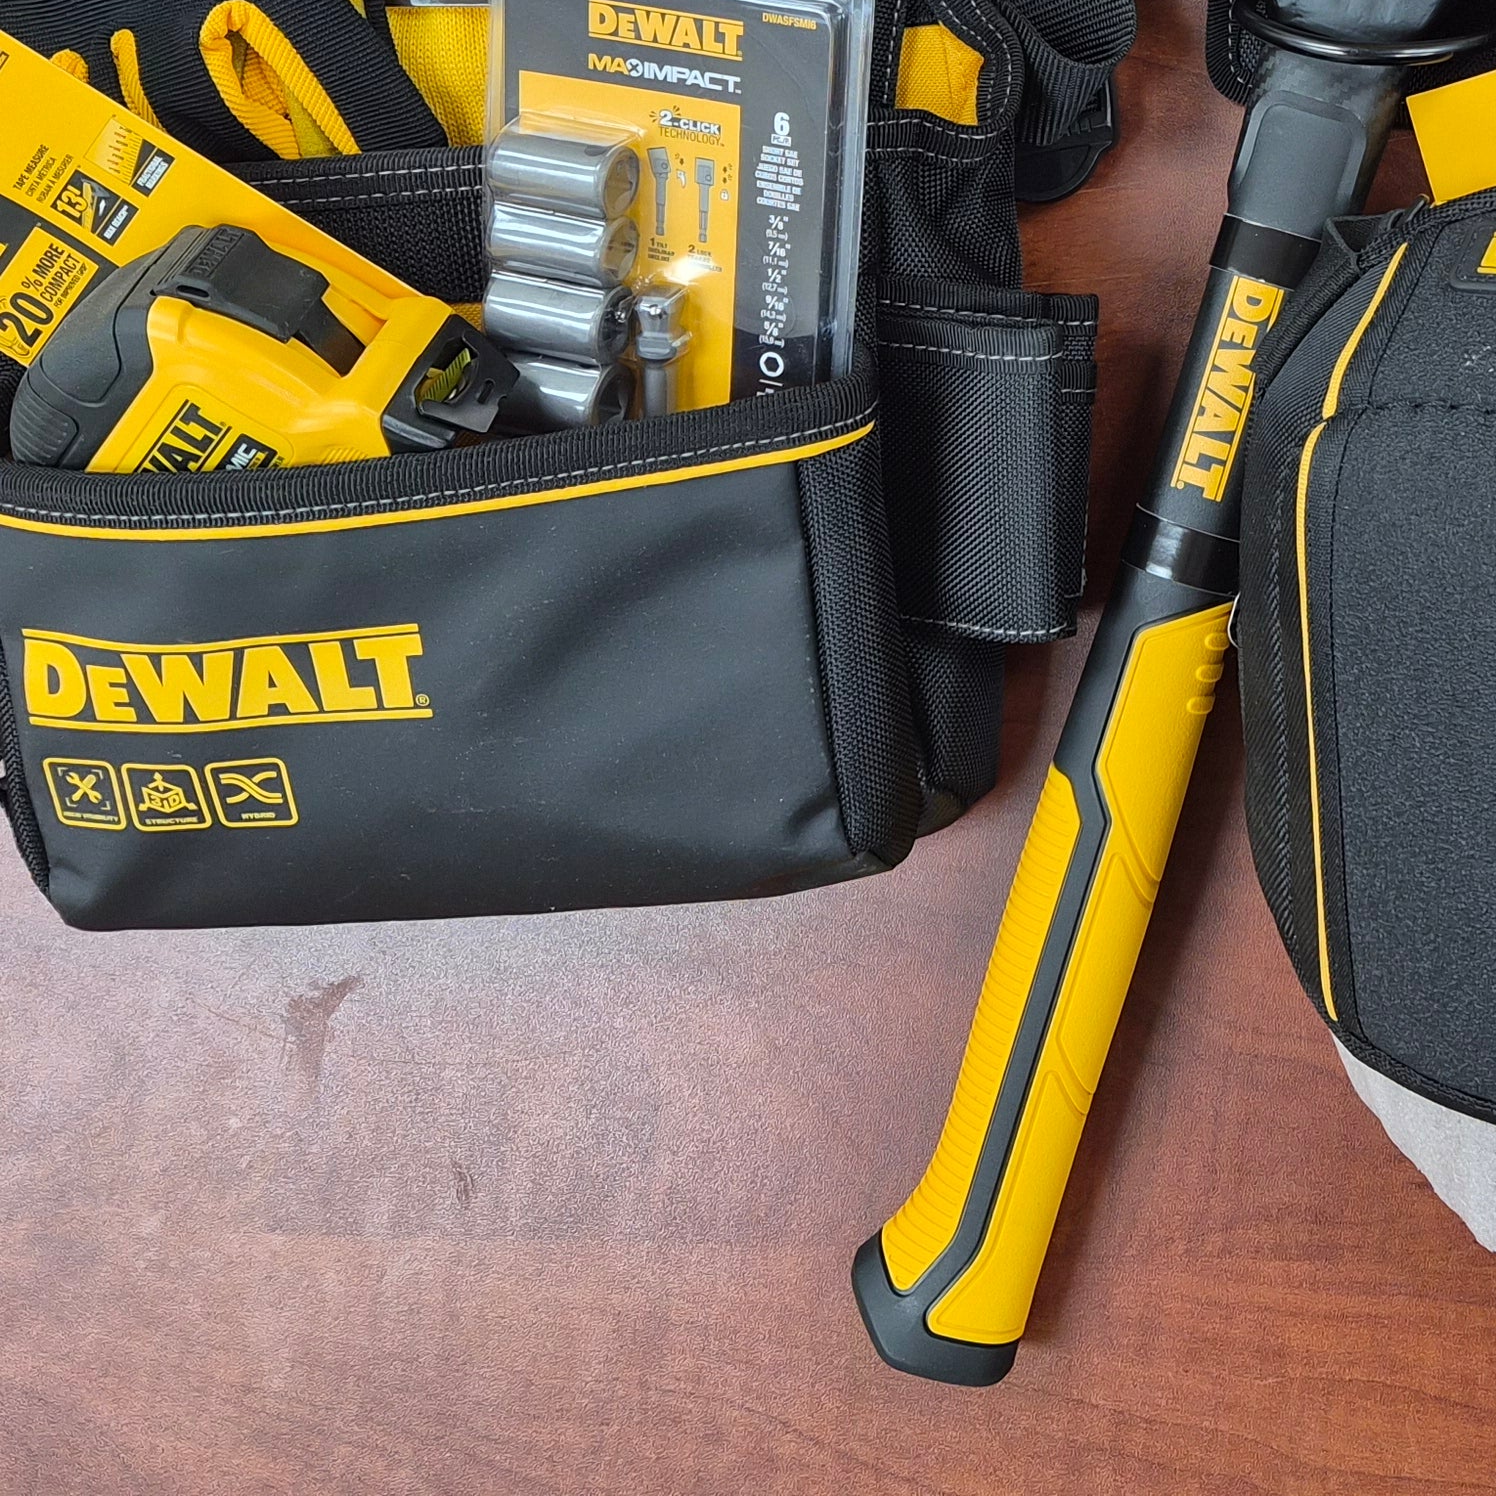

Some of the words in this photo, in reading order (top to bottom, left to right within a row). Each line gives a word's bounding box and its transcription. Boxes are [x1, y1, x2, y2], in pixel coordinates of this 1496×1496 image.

[589, 2, 743, 55] DEWALT
[660, 109, 720, 135] 2-CLICK
[660, 126, 721, 146] TECHNOLOGY
[774, 112, 790, 136] 6
[13, 171, 29, 190] TAPE
[24, 144, 50, 176] MEASURE
[25, 178, 41, 198] CINTA
[32, 243, 65, 280] MORE
[40, 253, 80, 303] COMPACT
[1182, 279, 1282, 501] DEWALT
[24, 633, 423, 724] DEWALT
